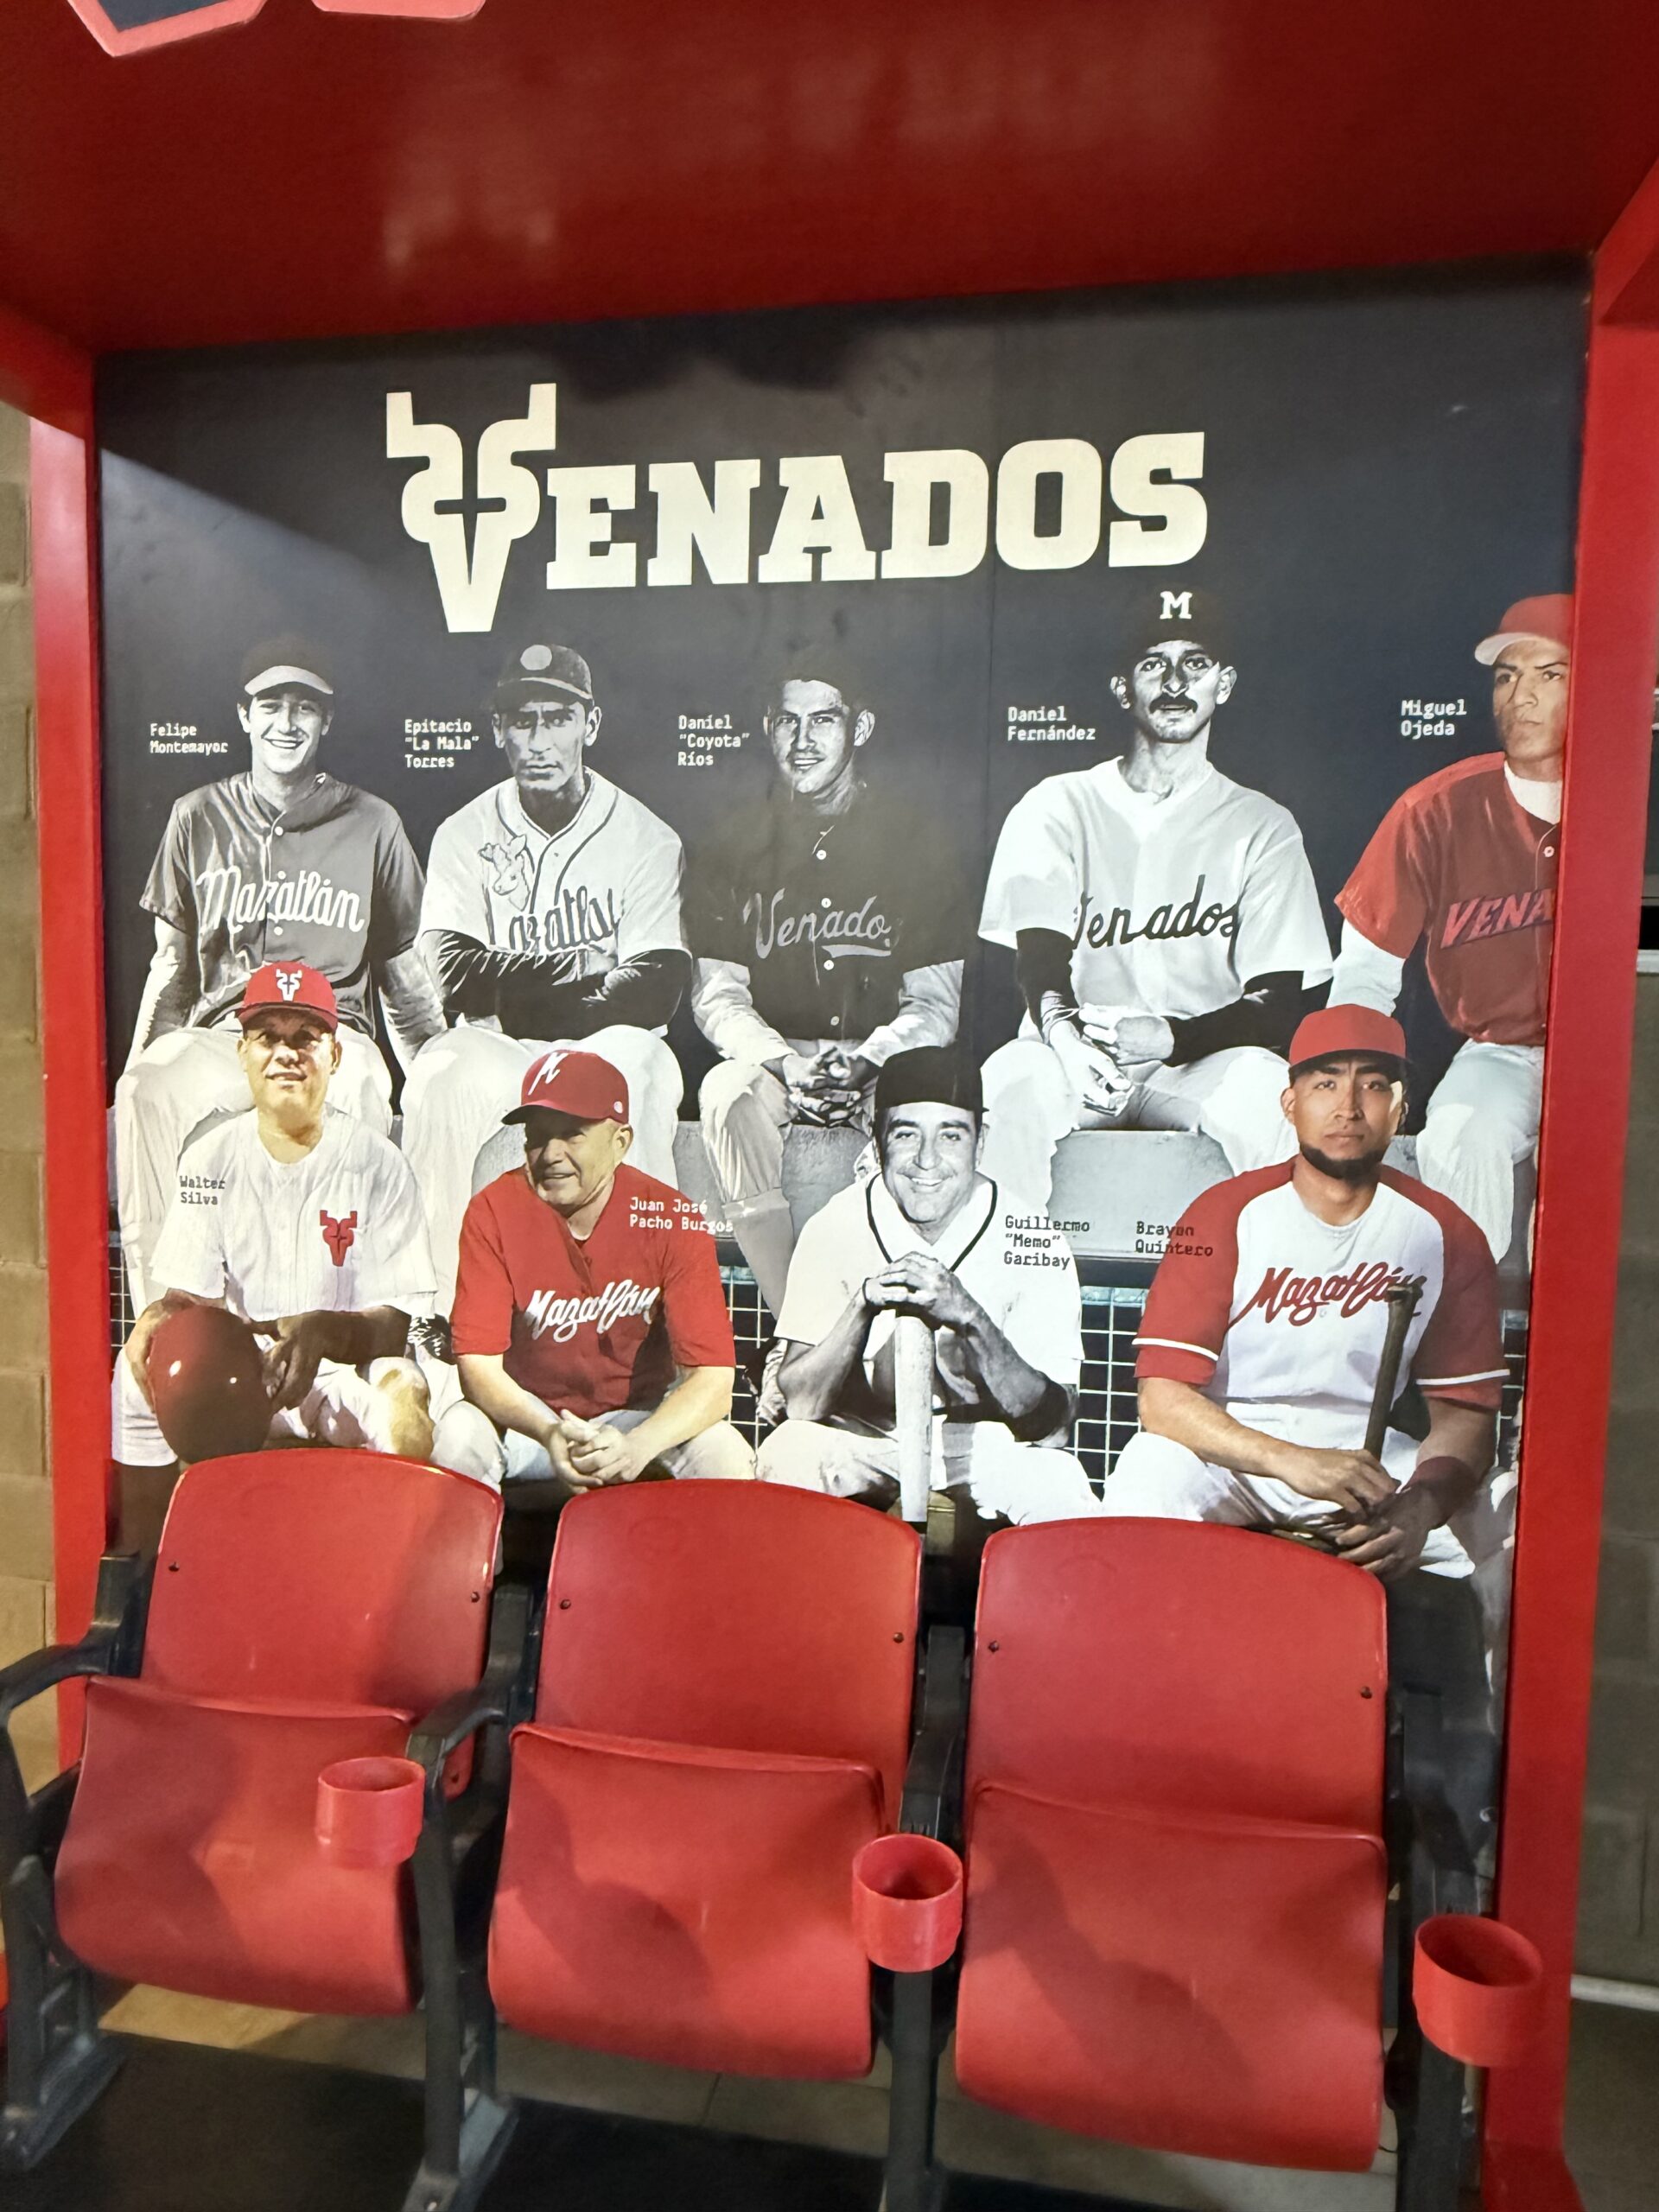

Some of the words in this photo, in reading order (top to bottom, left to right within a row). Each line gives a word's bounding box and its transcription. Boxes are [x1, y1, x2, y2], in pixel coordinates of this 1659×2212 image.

[385, 383, 1208, 633] VENADOS
[1160, 590, 1193, 620] M
[1007, 705, 1067, 722] Daniel
[1401, 698, 1467, 720] Miguel
[149, 722, 197, 739] Felipe
[404, 718, 472, 735] Epitacio
[678, 714, 733, 730] Daniel
[1401, 719, 1455, 741] Ojeda
[1007, 724, 1096, 741] Fernández
[149, 740, 229, 756] Montemayor
[404, 753, 454, 768] Torres
[742, 887, 904, 959] Venado
[179, 1175, 226, 1189] Walter
[180, 1192, 218, 1205] Silva
[629, 1196, 664, 1211] Juan
[672, 1198, 708, 1215] José
[629, 1213, 673, 1230] Pacho
[681, 1216, 734, 1235] Burgos
[1005, 1215, 1090, 1232] Guillermo
[1135, 1238, 1214, 1257] Quintero
[1003, 1250, 1071, 1271] Garibay
